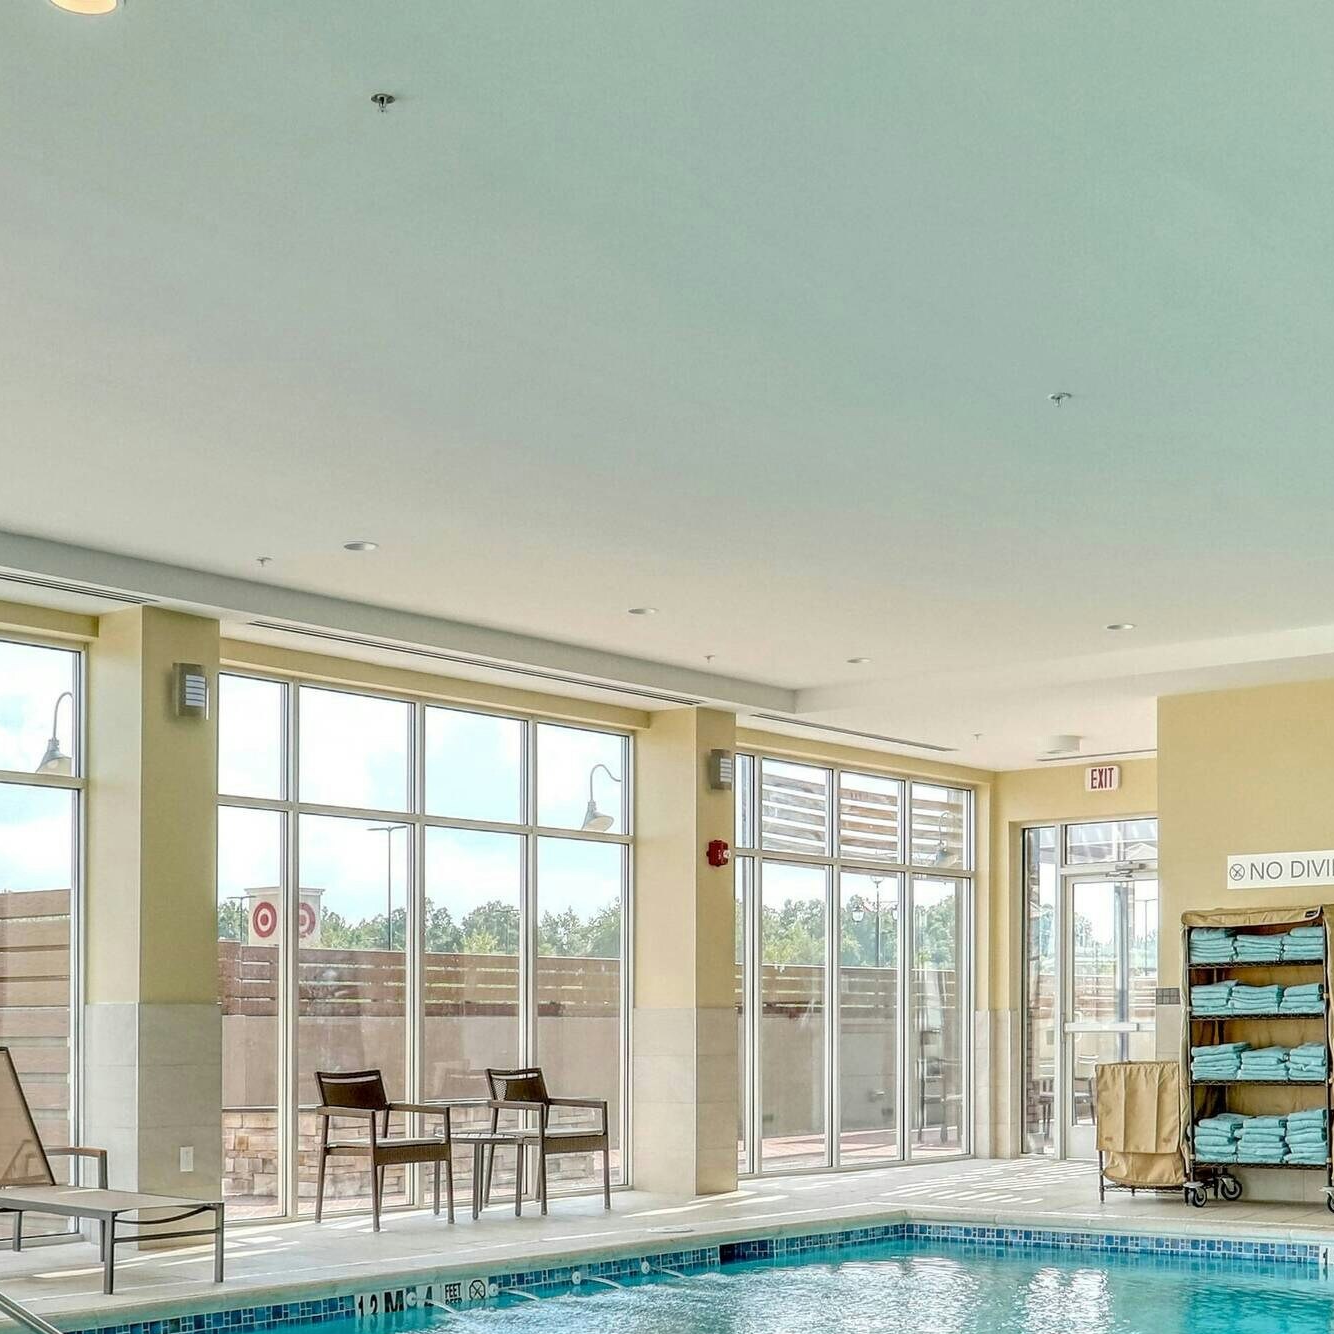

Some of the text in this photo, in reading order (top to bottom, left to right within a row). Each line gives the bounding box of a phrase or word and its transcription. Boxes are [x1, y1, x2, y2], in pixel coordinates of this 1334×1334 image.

[1090, 768, 1114, 789] EXIT
[1250, 861, 1284, 880] NO
[445, 1283, 461, 1298] FEET
